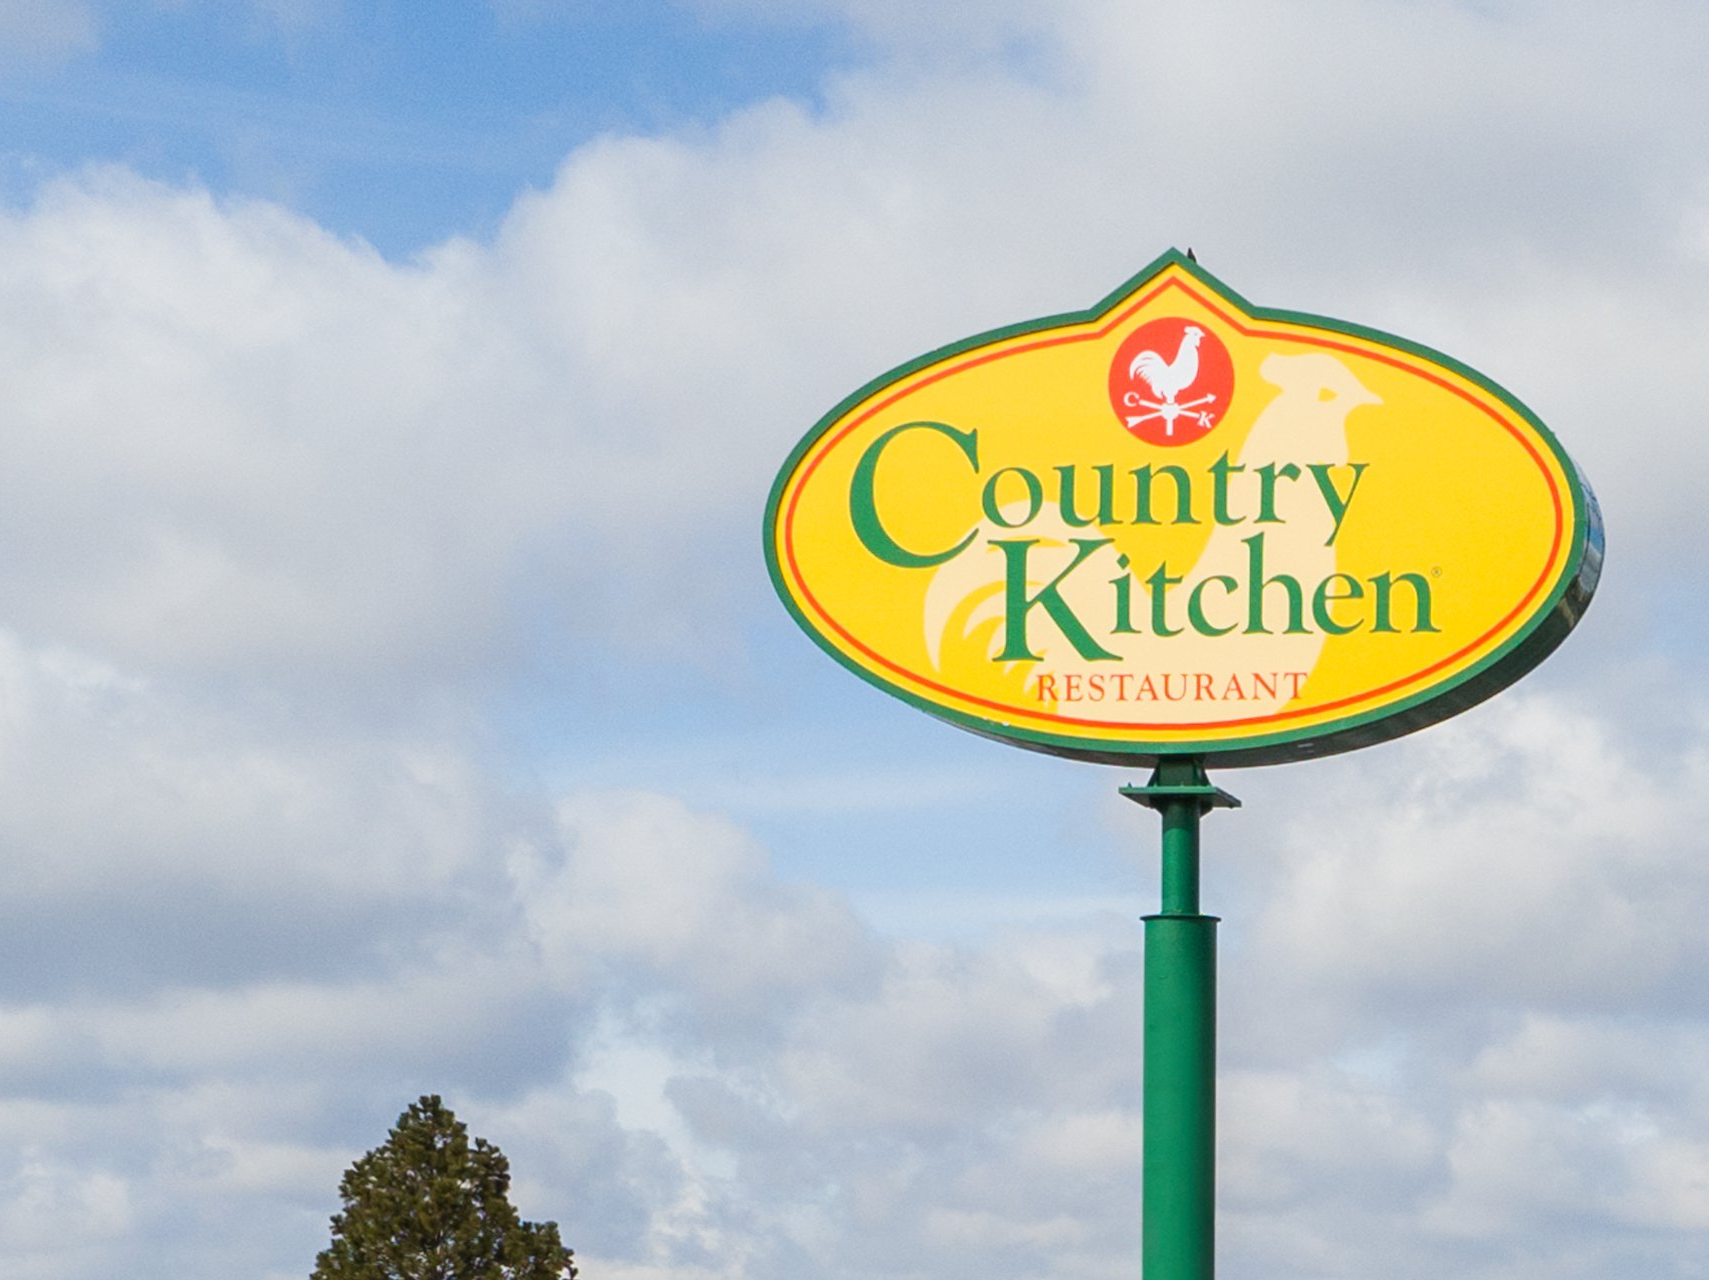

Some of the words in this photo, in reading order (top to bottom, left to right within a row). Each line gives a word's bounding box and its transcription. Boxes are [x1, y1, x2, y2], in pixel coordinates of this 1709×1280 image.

[849, 421, 1370, 568] Country
[992, 534, 1442, 663] Kitchen
[1036, 671, 1309, 703] RESTAURANT
